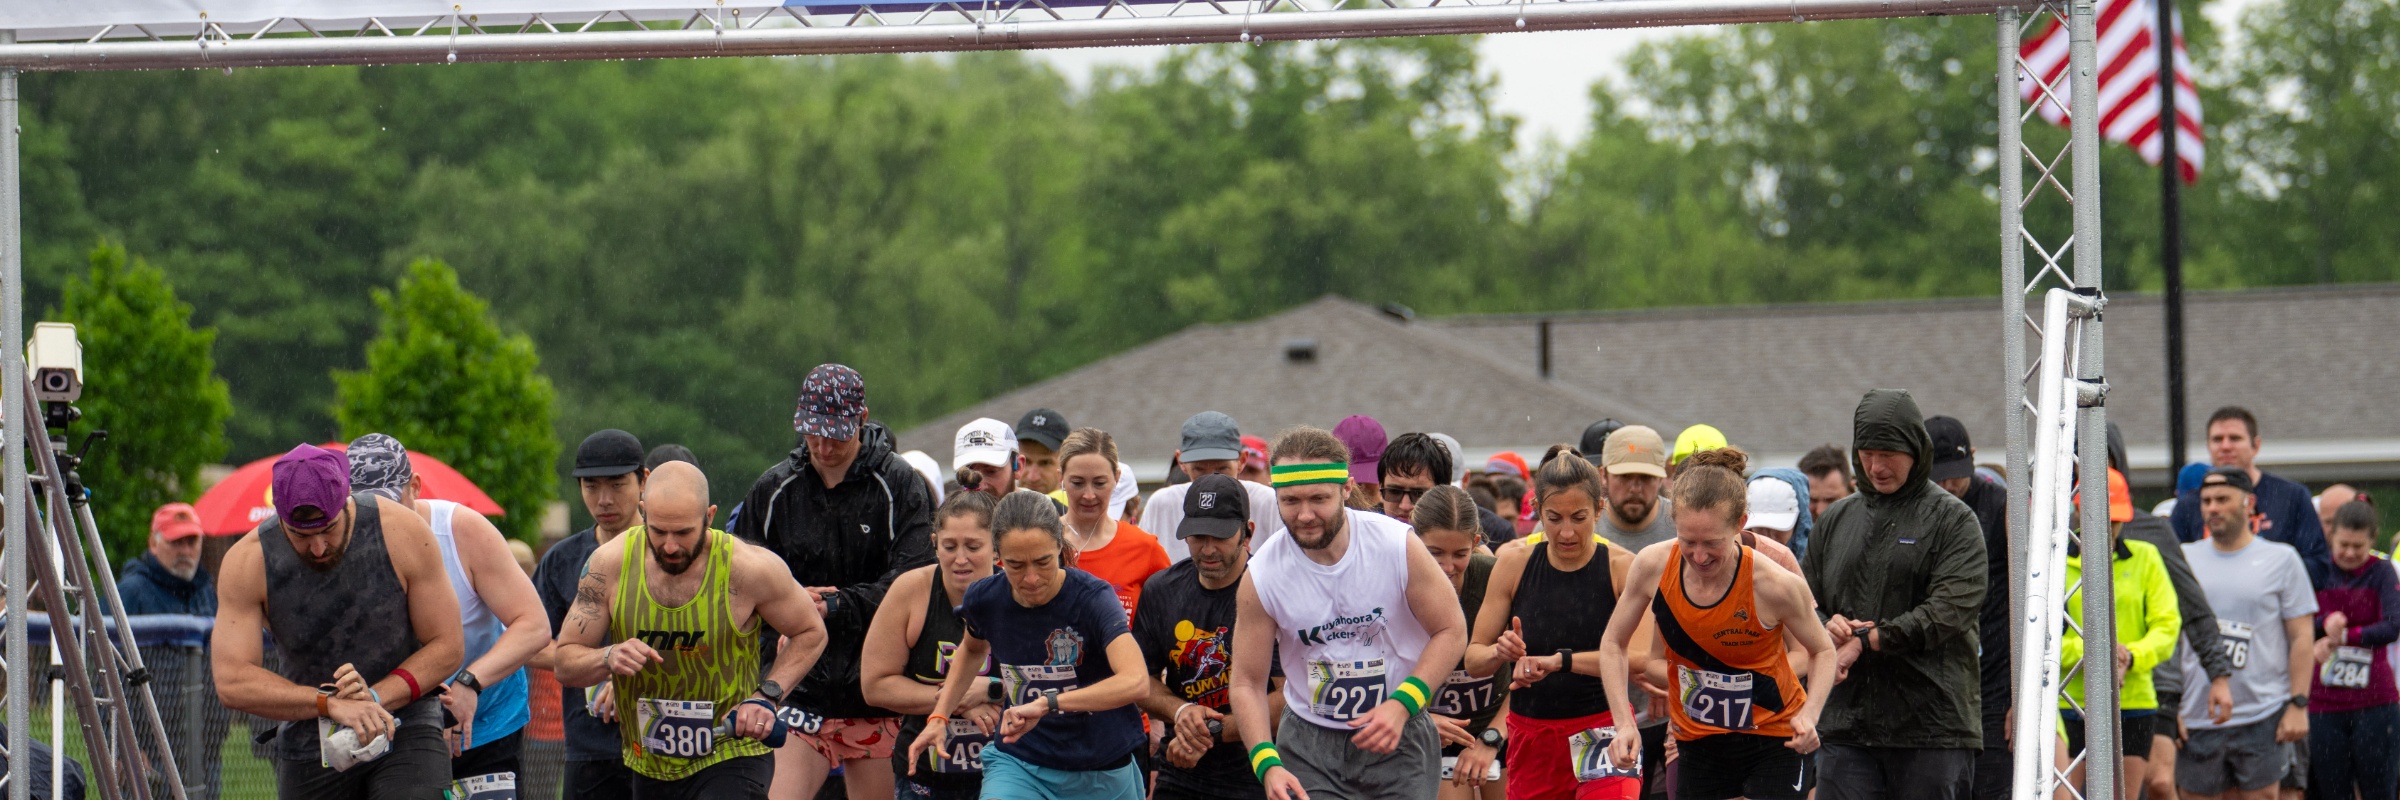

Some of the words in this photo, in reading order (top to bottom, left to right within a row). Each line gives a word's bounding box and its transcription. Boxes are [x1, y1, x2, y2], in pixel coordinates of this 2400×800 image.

[1200, 494, 1213, 507] 22
[1712, 628, 1743, 640] CENTRAL
[1744, 629, 1761, 638] PARK
[1185, 671, 1231, 699] SUMM
[2332, 661, 2370, 688] 284
[1331, 683, 1385, 719] 227
[1444, 683, 1493, 715] 317
[1698, 694, 1751, 728] 217
[660, 724, 712, 757] 380
[1596, 747, 1643, 775] 44
